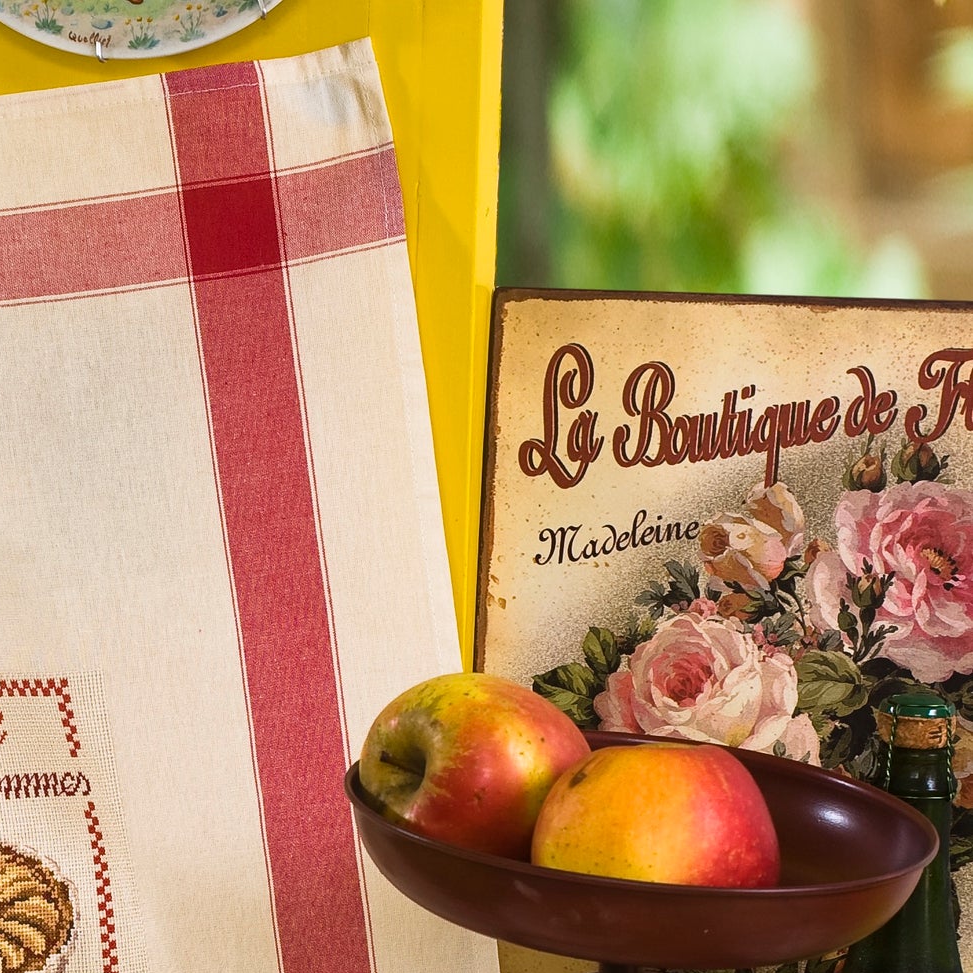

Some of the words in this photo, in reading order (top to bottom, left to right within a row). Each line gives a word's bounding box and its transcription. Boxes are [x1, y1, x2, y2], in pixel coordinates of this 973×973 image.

[518, 342, 605, 490] La
[613, 361, 840, 488] Boutique
[844, 365, 898, 437] de
[534, 509, 701, 566] Madeleine
